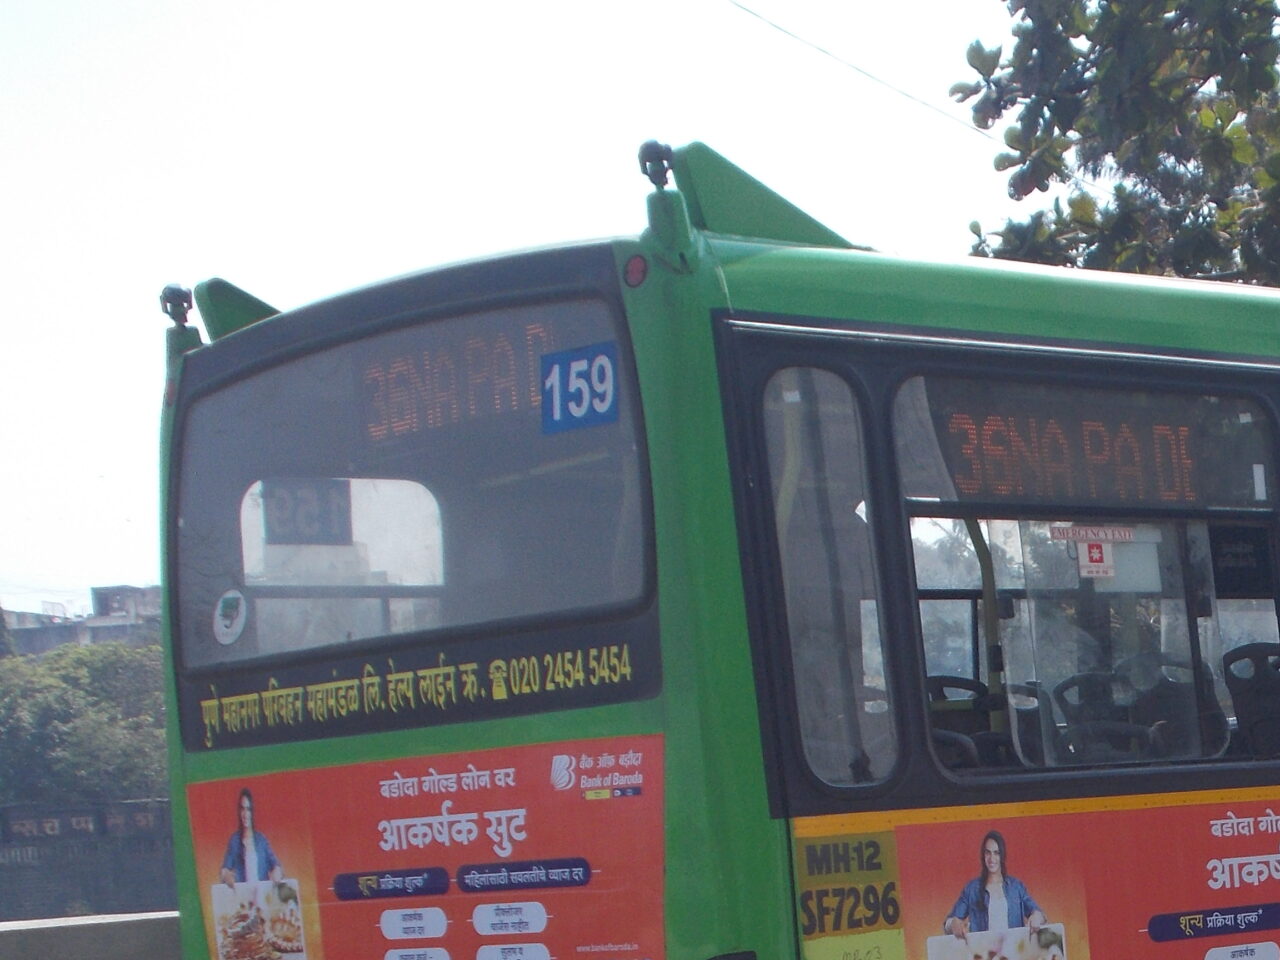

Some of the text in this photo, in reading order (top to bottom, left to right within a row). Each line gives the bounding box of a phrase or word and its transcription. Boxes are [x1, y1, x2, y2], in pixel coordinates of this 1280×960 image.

[545, 354, 614, 421] 159
[1050, 526, 1109, 540] EMERGENCY
[201, 684, 220, 748] पुणे
[220, 692, 261, 733] महानगर
[259, 677, 304, 726] परिवहन
[305, 668, 361, 722] महामंडळ
[387, 657, 415, 713] हेल्प
[509, 656, 541, 695] 020
[543, 650, 585, 690] 2454
[589, 643, 632, 686] 5454
[379, 764, 515, 798] बडोदा गोल्ड लोन वर
[580, 774, 602, 788] Bank
[612, 771, 643, 786] Baroda
[377, 800, 528, 858] आकर्षक सुट
[1210, 810, 1254, 837] बडोदा
[464, 868, 508, 889] महिलांसाठी
[548, 867, 571, 882] व्याज
[572, 867, 584, 881] दर
[1179, 913, 1204, 936] शून्य
[1206, 912, 1235, 929] प्रक्रिया
